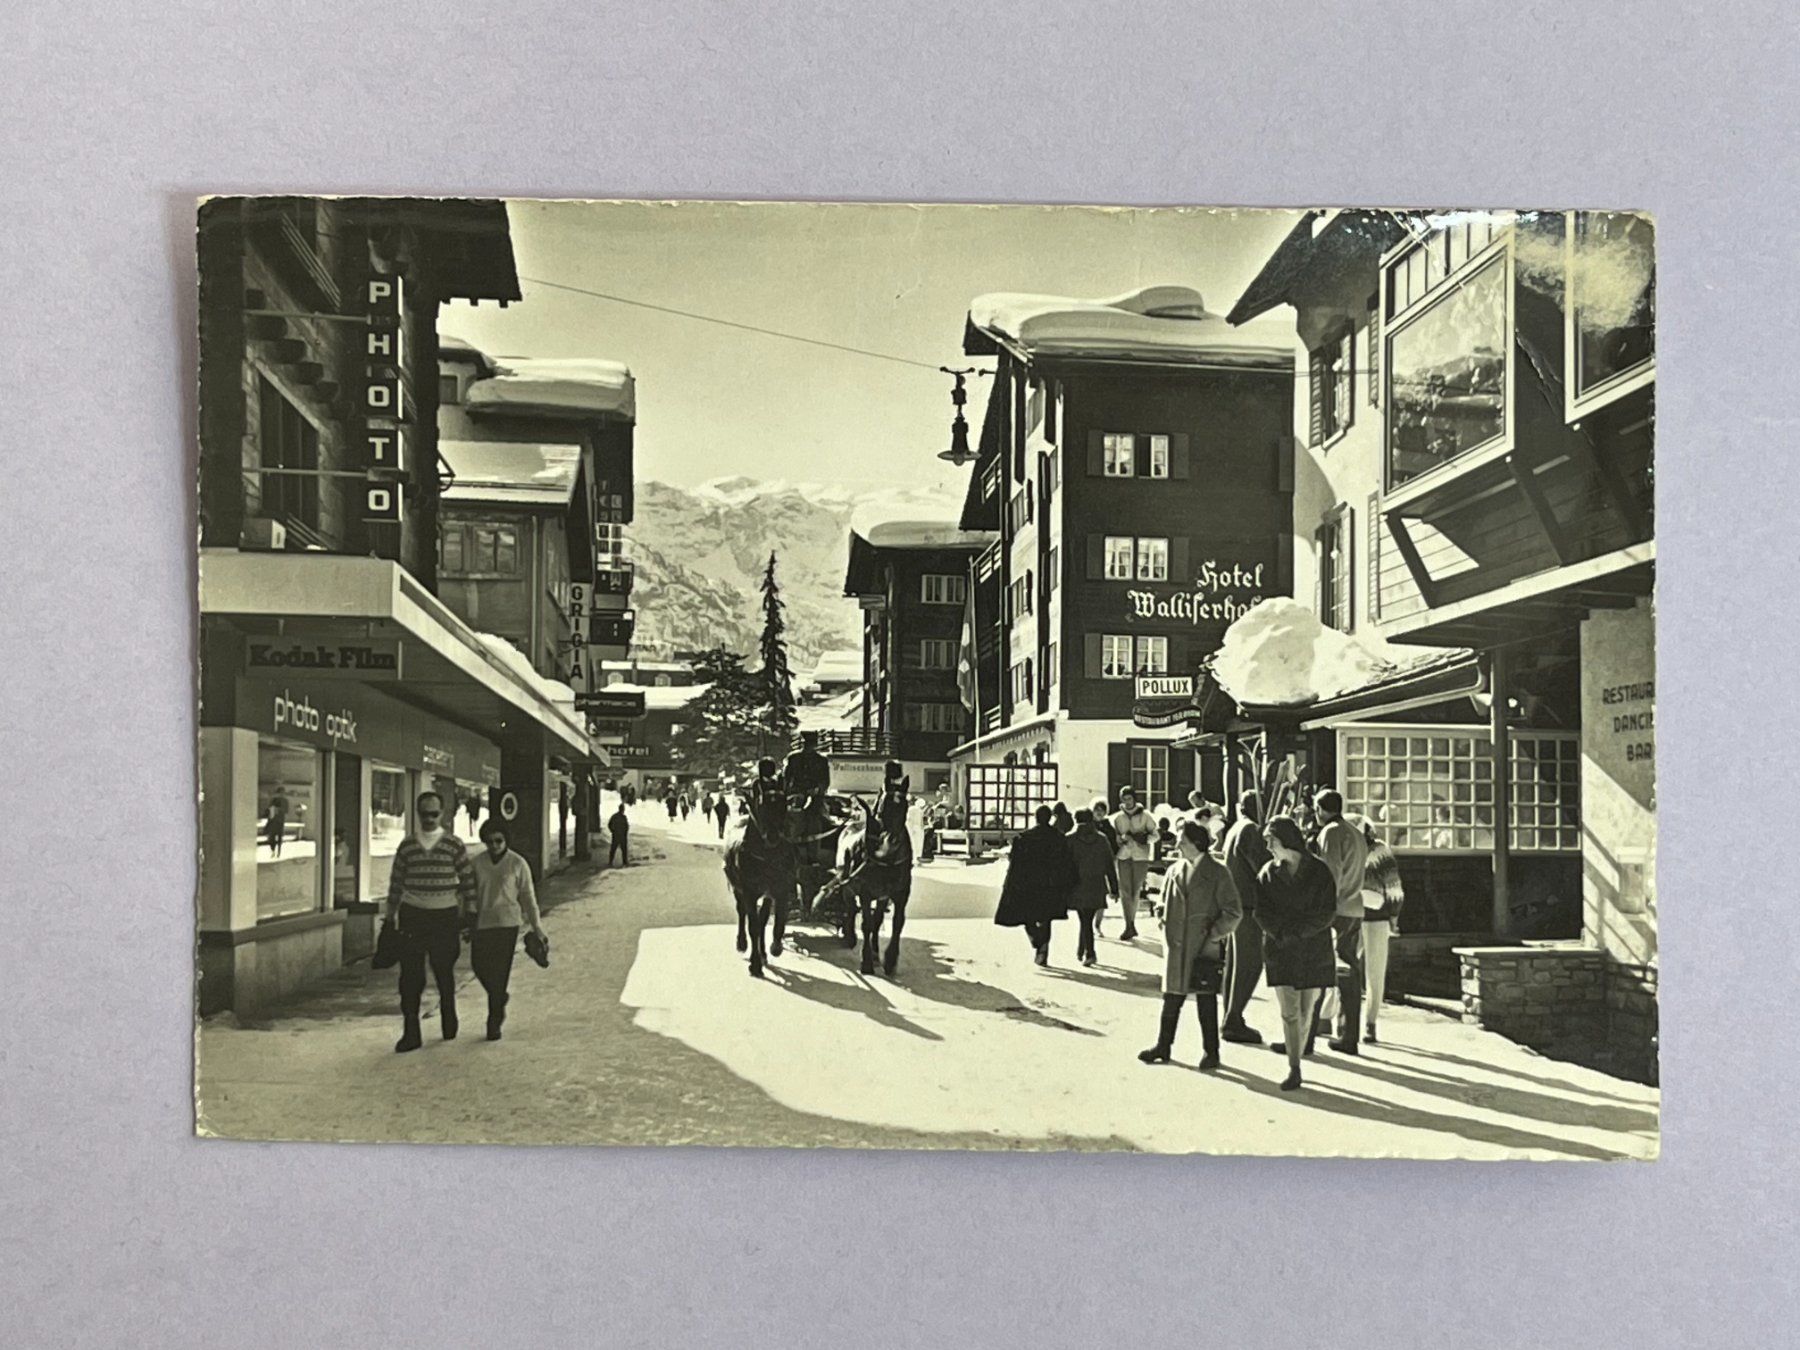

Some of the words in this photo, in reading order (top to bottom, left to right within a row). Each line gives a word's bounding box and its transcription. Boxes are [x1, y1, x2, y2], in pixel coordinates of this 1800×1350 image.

[367, 281, 391, 511] PHOTO
[1197, 560, 1264, 592] Hotel
[571, 586, 583, 679] GRIGIA
[250, 645, 336, 667] Kodak
[338, 647, 397, 669] Film
[1142, 680, 1189, 694] POLLUX
[275, 688, 320, 733] photo
[325, 708, 357, 743] optik
[1627, 742, 1652, 761] BAR
